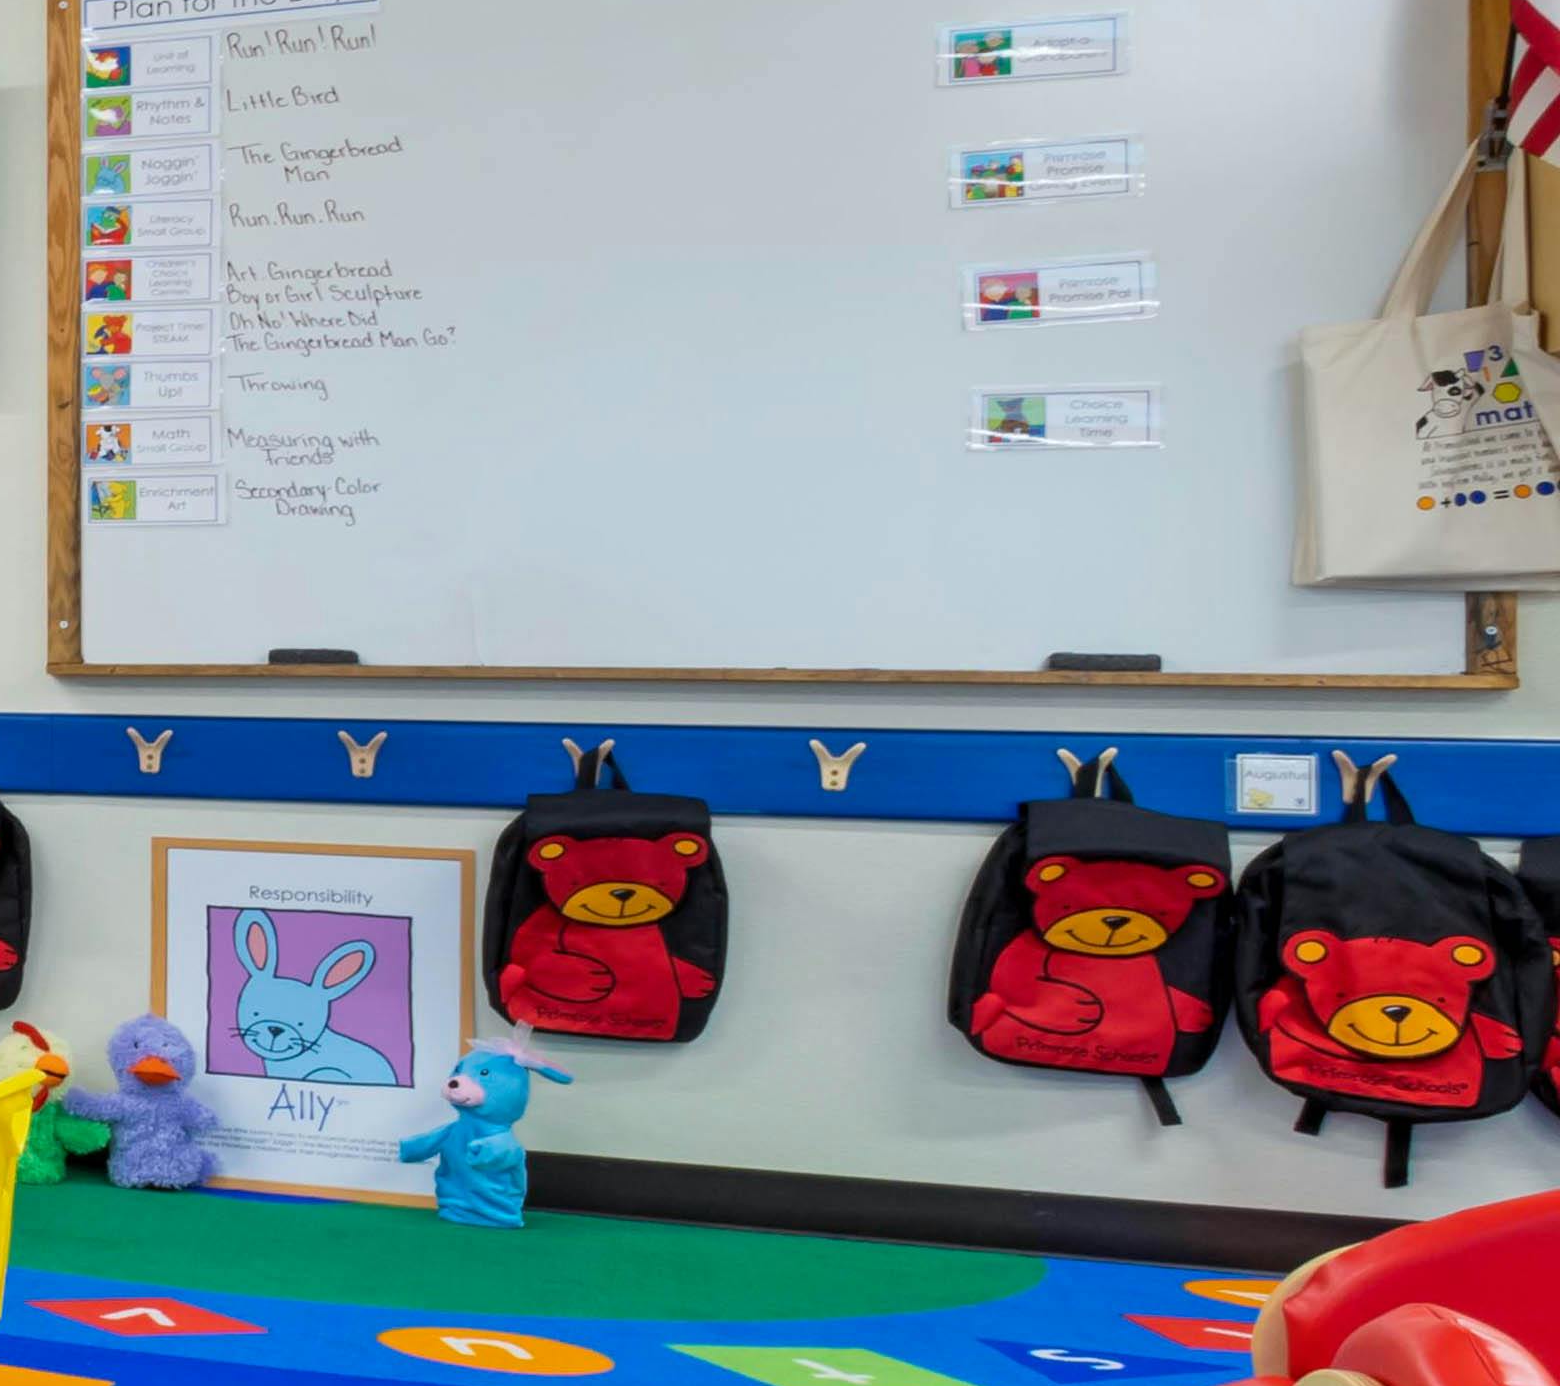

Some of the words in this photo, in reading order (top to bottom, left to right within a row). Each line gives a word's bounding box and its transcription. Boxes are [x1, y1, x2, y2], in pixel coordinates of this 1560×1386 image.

[135, 99, 190, 115] Rhythm
[194, 97, 205, 109] &
[291, 85, 340, 108] Bird
[148, 112, 193, 126] Notes
[225, 142, 275, 164] The
[280, 135, 403, 166] Gingerbread
[283, 165, 331, 183] Man
[266, 259, 393, 288] Gingerbread
[226, 283, 261, 311] Boy
[264, 291, 284, 304] or
[285, 282, 324, 304] Girl
[328, 284, 424, 310] Sculpture
[229, 312, 256, 330] Oh
[287, 309, 347, 328] Where
[347, 310, 379, 328] Did
[228, 335, 262, 354] The
[263, 333, 374, 358] Gingerbread
[379, 330, 418, 348] Man
[1488, 344, 1504, 362] 3
[143, 371, 200, 384] Thumbs
[227, 371, 330, 401] Throwing
[1474, 400, 1534, 427] mat
[151, 427, 192, 441] Math
[226, 427, 335, 454] Measuring
[338, 427, 380, 448] with
[138, 485, 215, 499] Enrichment
[166, 497, 187, 512] Art
[274, 498, 357, 526] Drawing
[248, 884, 374, 909] Responsibility
[267, 1082, 336, 1133] Ally
